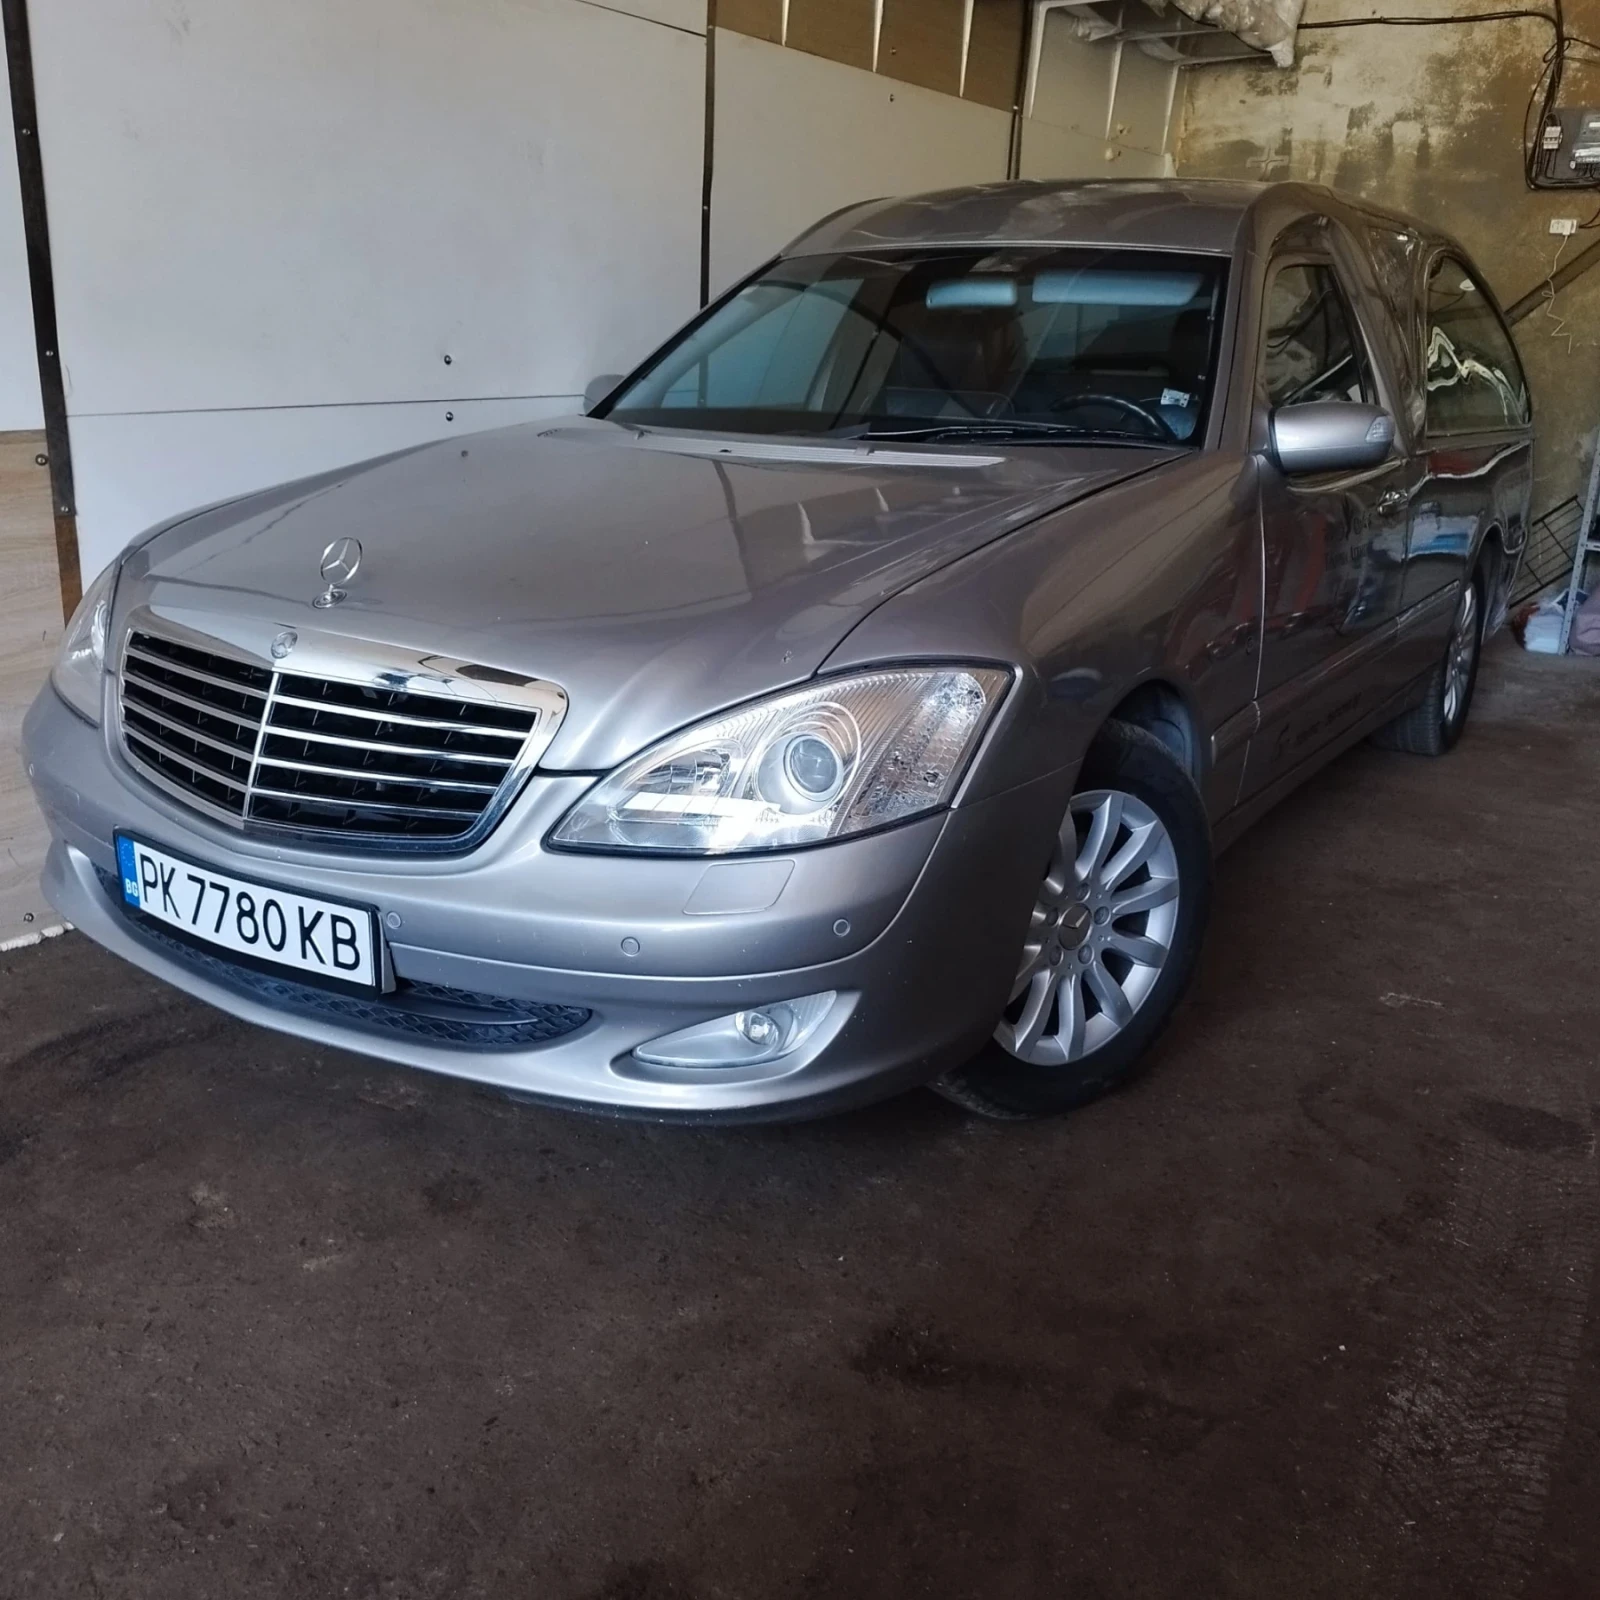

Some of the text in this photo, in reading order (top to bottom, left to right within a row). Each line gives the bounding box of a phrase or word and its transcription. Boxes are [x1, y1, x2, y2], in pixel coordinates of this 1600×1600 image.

[125, 877, 138, 897] BG
[140, 853, 360, 971] PK 7780 KB
